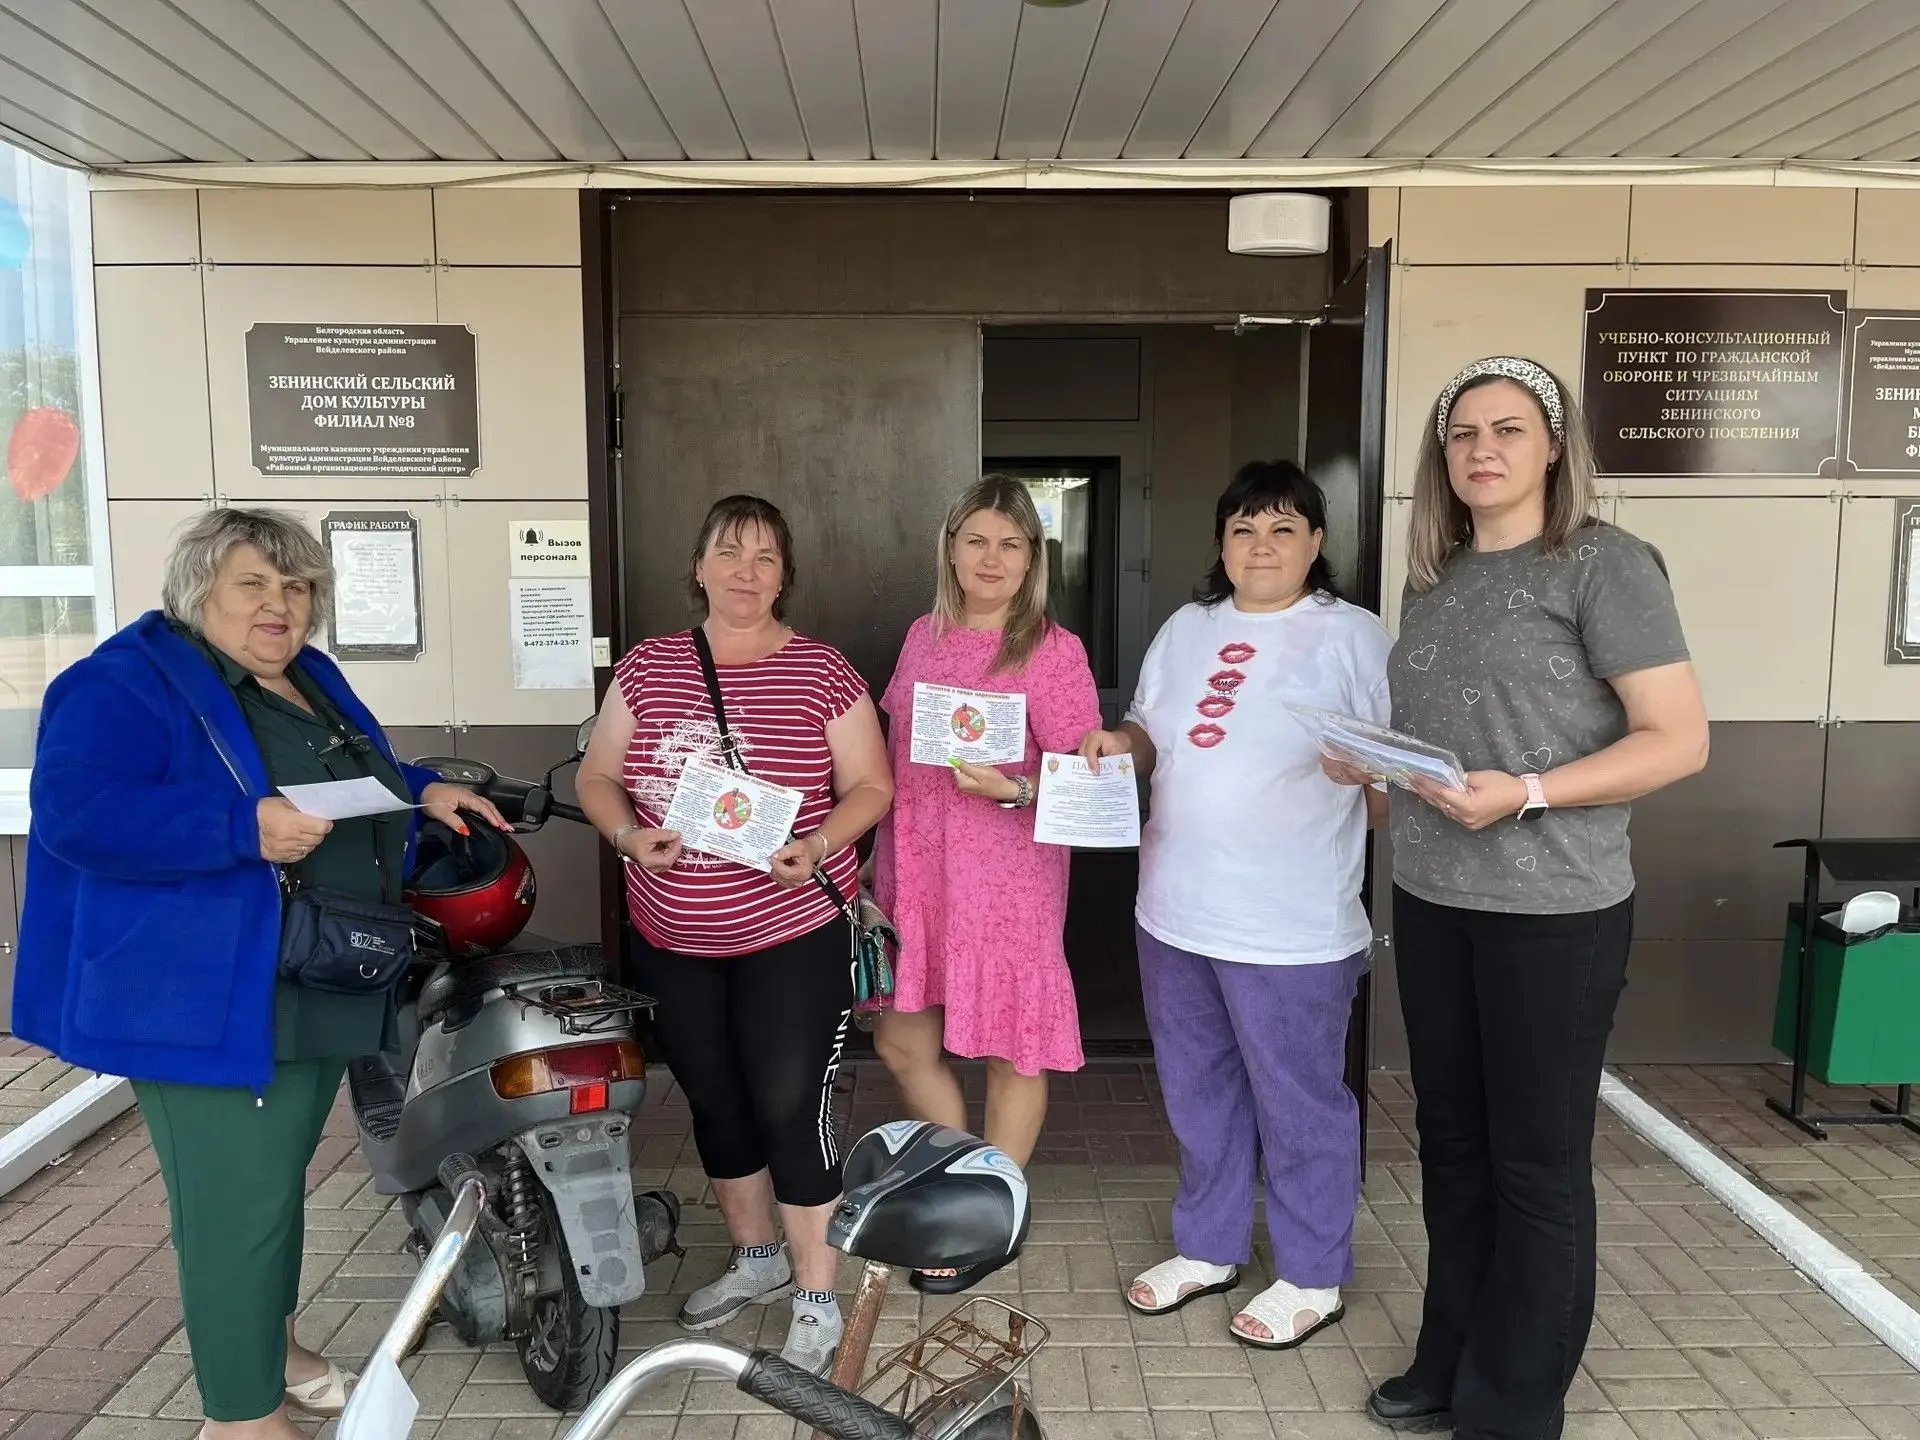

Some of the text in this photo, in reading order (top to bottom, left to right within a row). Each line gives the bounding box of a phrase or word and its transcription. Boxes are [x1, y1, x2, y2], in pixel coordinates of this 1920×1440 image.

[316, 327, 372, 335] Белгородская
[284, 336, 332, 345] Управление
[333, 338, 372, 346] культуры
[1599, 331, 1831, 346] УЧЕБНО-КОНСУЛЬТАЦИОННЫЙ
[316, 346, 407, 355] Вейделевского района
[1618, 349, 1811, 365] ПУНКТ ПО ГРАЖДАНСКОЙ
[268, 373, 456, 390] ЗЕНИНСКИЙ СЕЛЬСКИЙ
[1603, 368, 1819, 383] ОБОРОНЕ И ЧРЕЗВЫЧАЙНЫМ
[1666, 389, 1759, 402] СИТУАЦИЯМ
[301, 395, 426, 411] ДОМ КУЛЬТУРЫ
[1661, 408, 1761, 420] ЗЕНИНСКОГО
[314, 414, 415, 428] ФИЛИАЛ №8
[1619, 427, 1800, 439] СЕЛЬСКОГО ПОСЕЛЕНИЯ
[260, 445, 329, 453] Муниципального
[269, 455, 462, 463] культуры администрации Вейделевского района
[328, 521, 411, 530] ГРАФИК РАБОТЫ
[548, 539, 582, 547] Вызов
[520, 554, 577, 562] персонала
[524, 639, 579, 647] 8-472-374-23-37
[823, 1009, 851, 1084] NIKE
